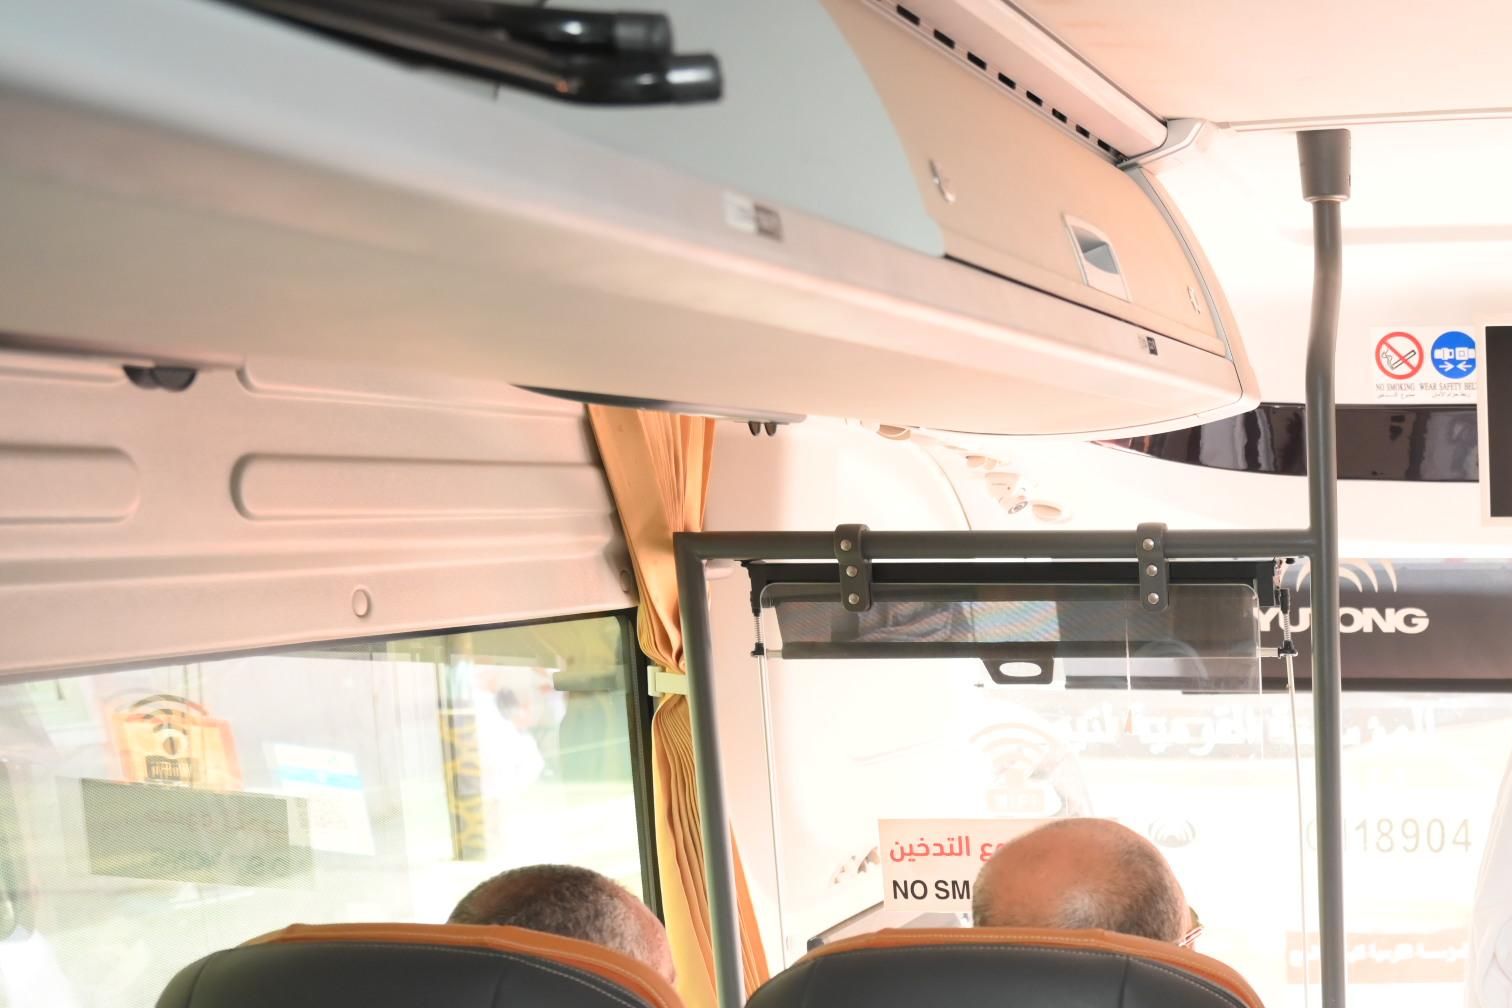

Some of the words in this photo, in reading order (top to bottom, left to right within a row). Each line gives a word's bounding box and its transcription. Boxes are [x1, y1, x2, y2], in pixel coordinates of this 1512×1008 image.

[1463, 382, 1477, 391] BEL
[1253, 607, 1430, 634] YUONG
[889, 835, 971, 863] التدخين
[892, 879, 928, 900] NO
